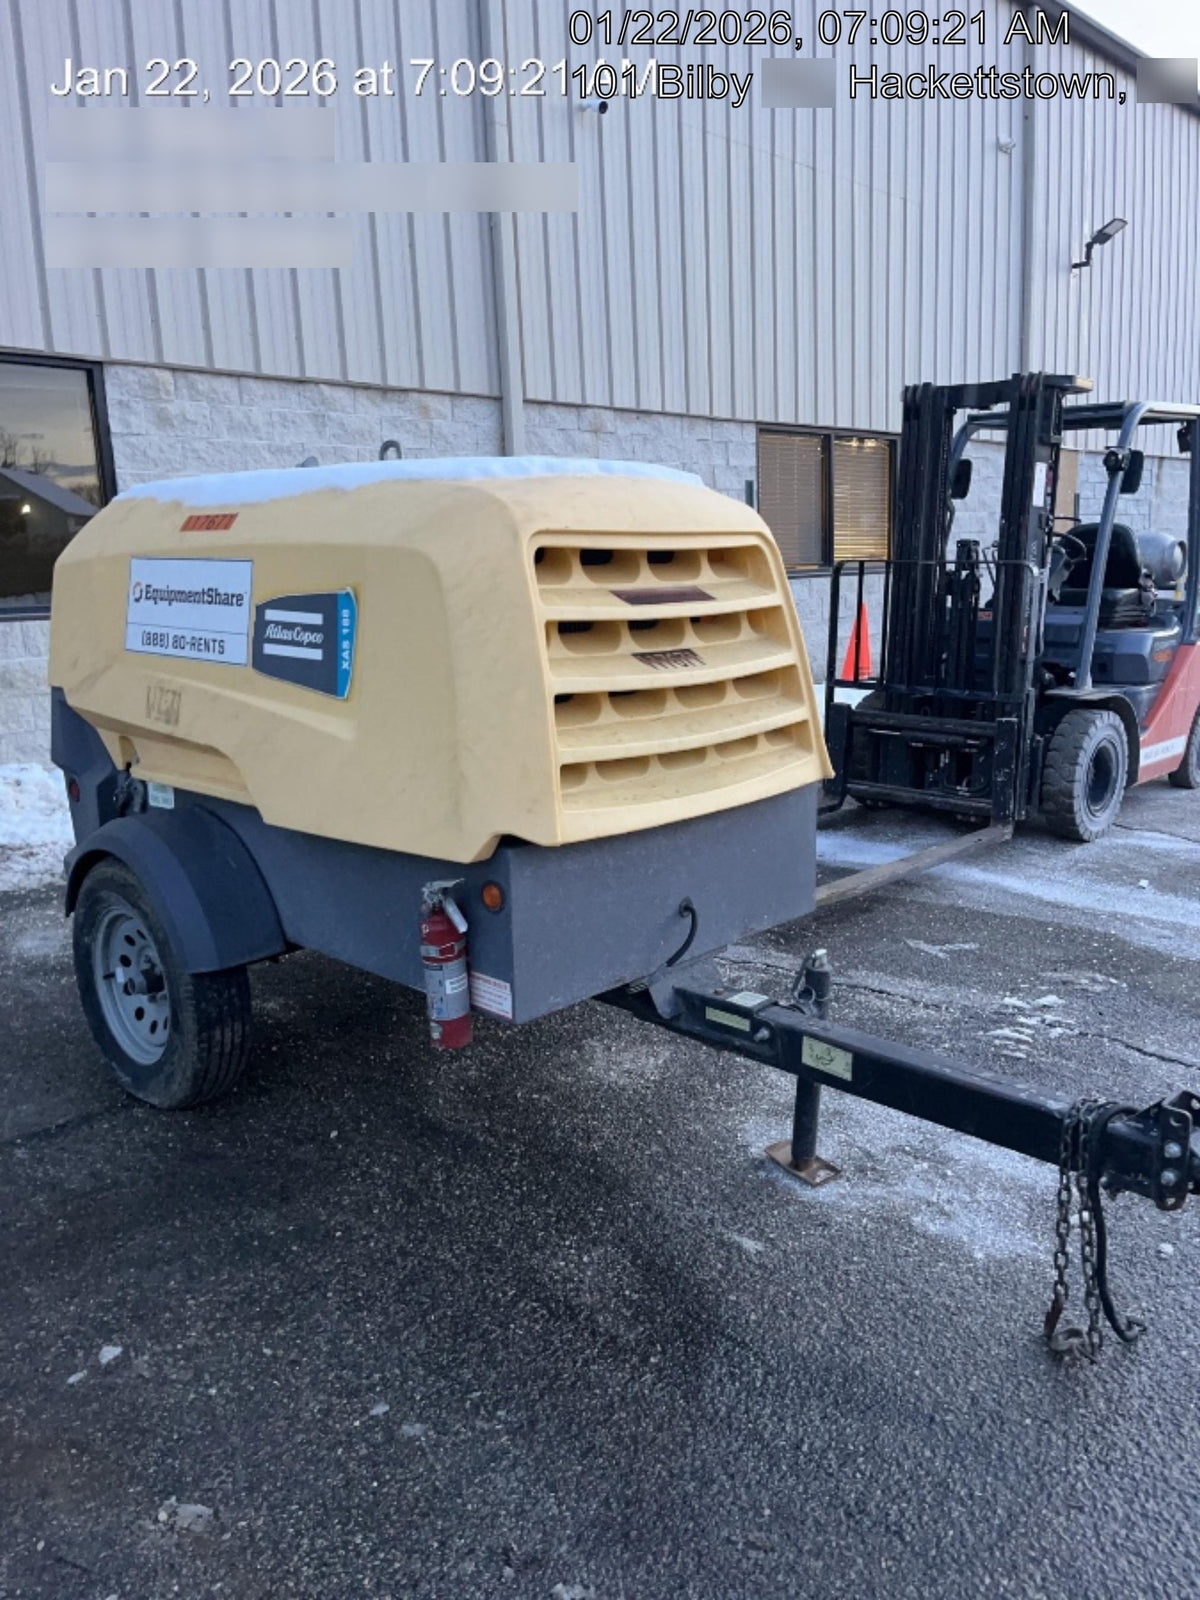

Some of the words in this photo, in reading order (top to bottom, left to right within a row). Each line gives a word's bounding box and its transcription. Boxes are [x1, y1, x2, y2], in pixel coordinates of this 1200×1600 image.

[144, 584, 244, 606] EquipmentShare
[141, 630, 169, 649] (888)
[171, 634, 225, 655] 80-RENTS
